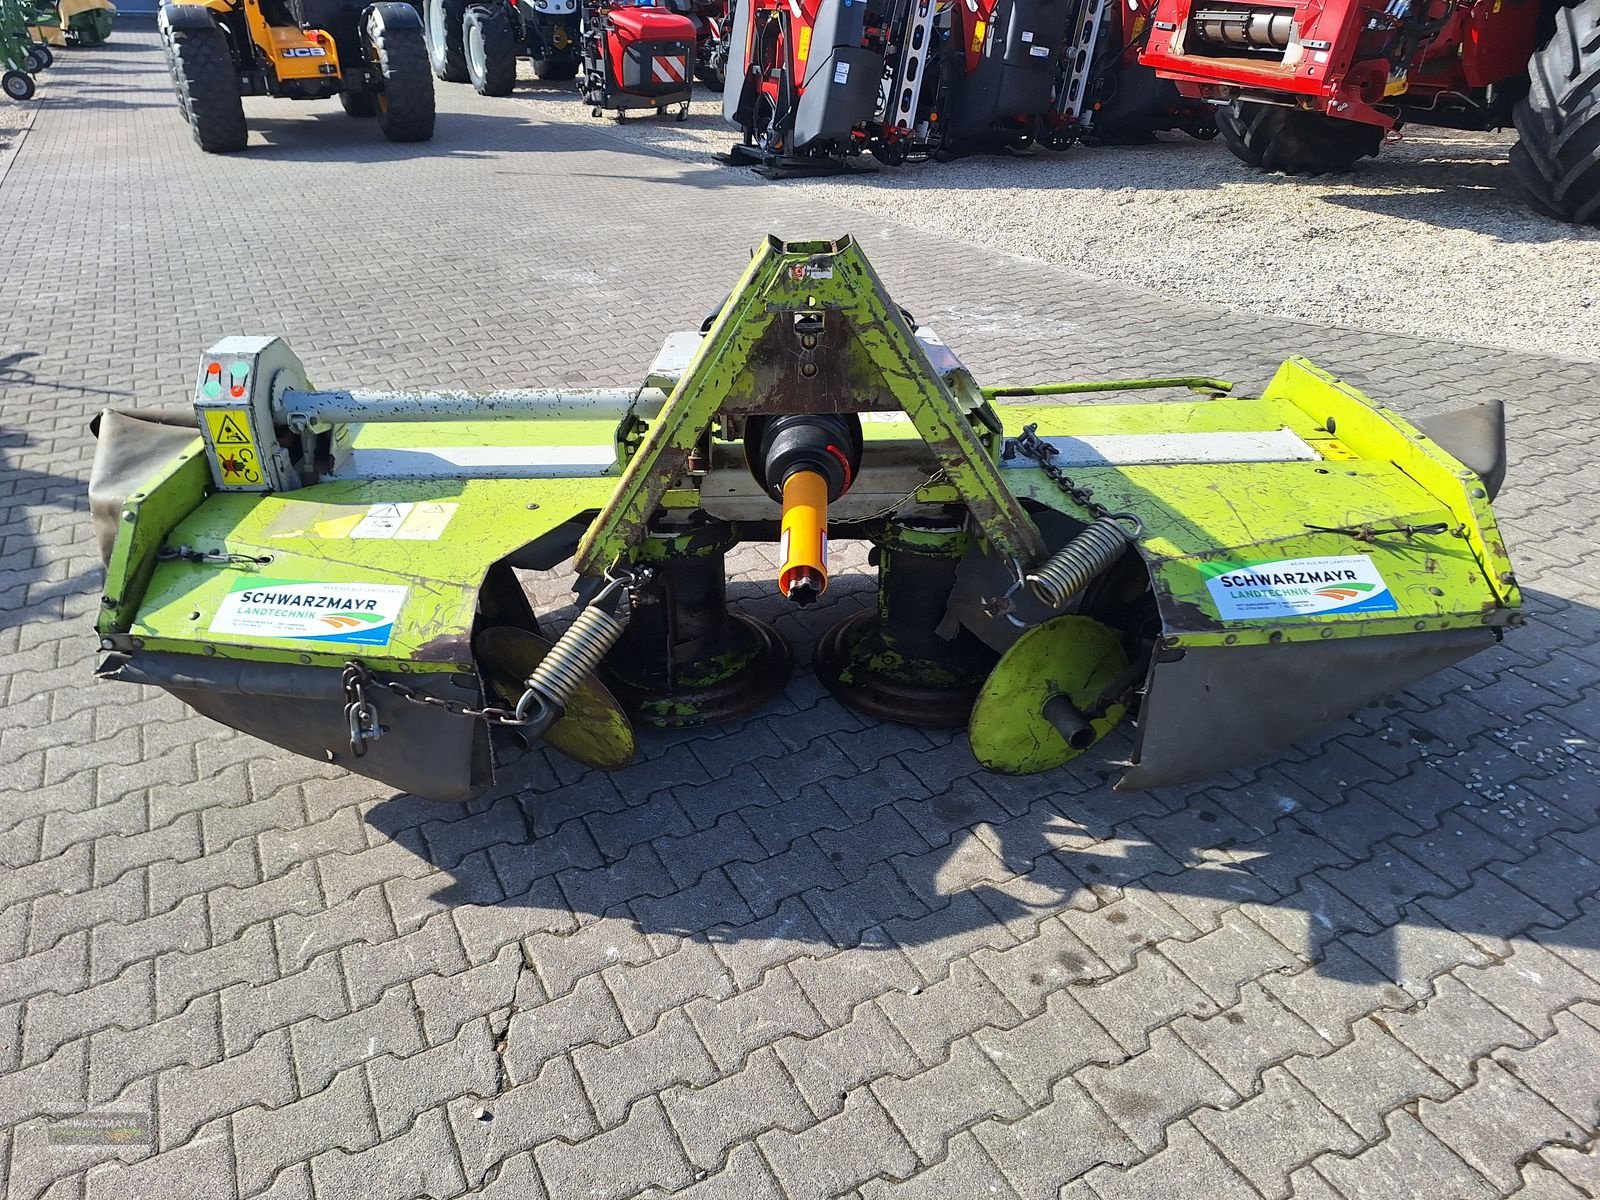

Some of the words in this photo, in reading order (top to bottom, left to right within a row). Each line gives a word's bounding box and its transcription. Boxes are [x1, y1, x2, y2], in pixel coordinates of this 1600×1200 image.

[283, 47, 326, 58] JCB
[1221, 570, 1357, 587] SCHWARZMAYR
[1230, 587, 1311, 599] LANDTECHNIK
[240, 592, 377, 611] SCHWARZMAYR
[237, 607, 315, 619] LANDTECHNIK
